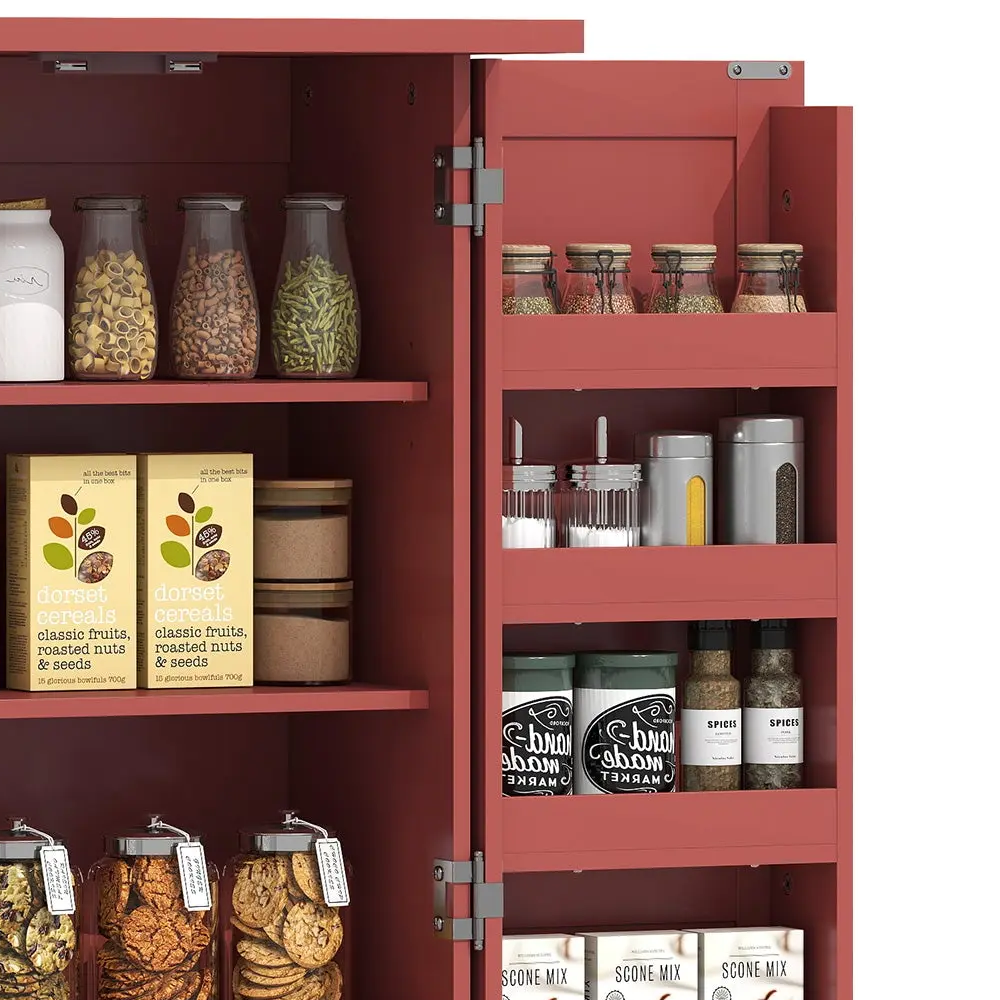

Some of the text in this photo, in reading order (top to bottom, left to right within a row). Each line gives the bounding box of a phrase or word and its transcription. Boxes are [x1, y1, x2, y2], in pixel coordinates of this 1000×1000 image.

[37, 585, 108, 604] dorset
[154, 583, 224, 601] dorset
[37, 605, 116, 625] cereals
[154, 603, 232, 623] cereals
[37, 628, 131, 641] classic fruits,
[155, 625, 248, 639] classic fruits,
[37, 643, 126, 656] roasted nuts
[155, 640, 243, 653] roasted nuts
[37, 658, 92, 671] & seeds
[155, 655, 209, 668] & seeds
[109, 675, 126, 684] 700g
[707, 720, 737, 729] SPICES
[769, 718, 799, 727] SPICES
[615, 964, 681, 984] SCONE MIX
[722, 960, 787, 980] SCONE MIX
[501, 967, 568, 987] SCONE MIX
